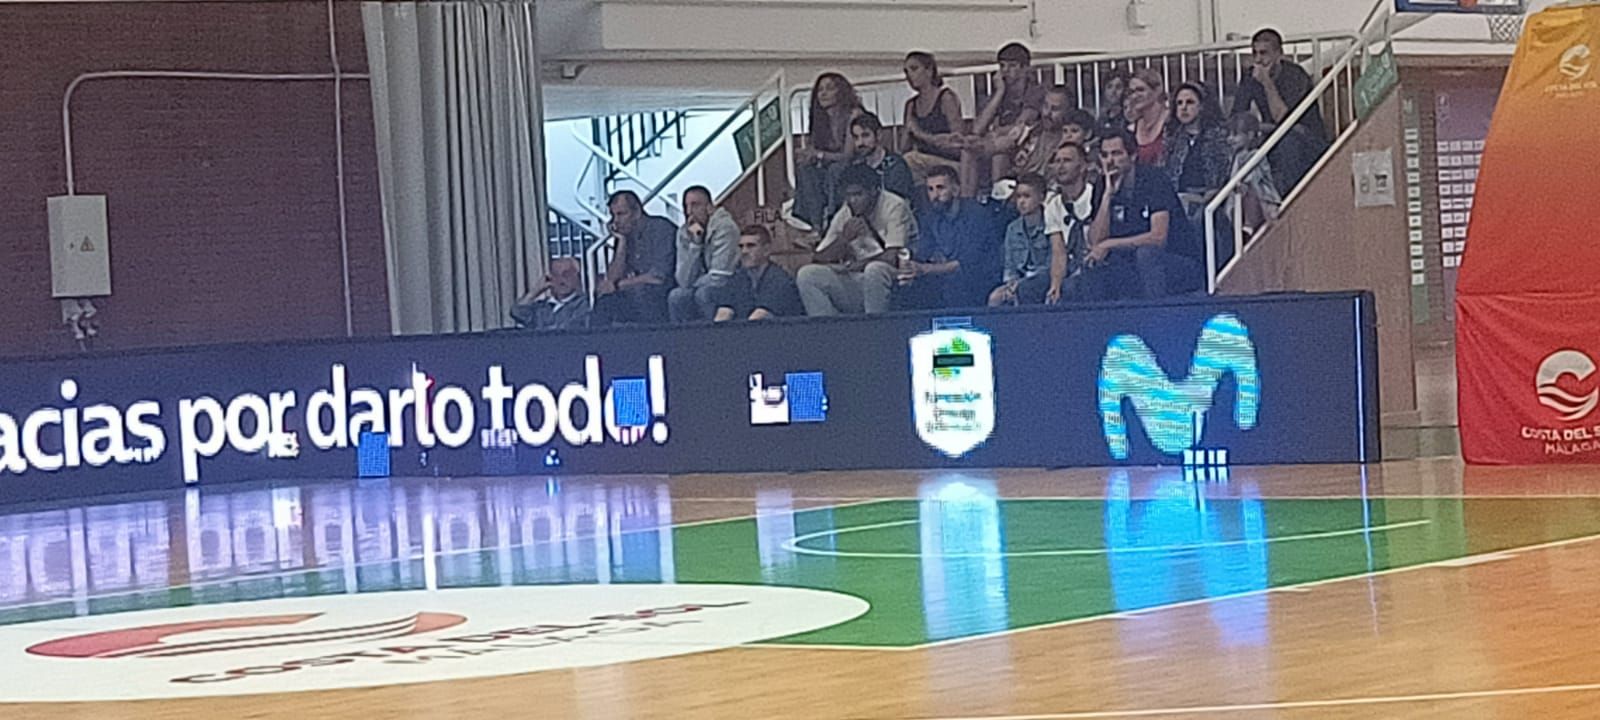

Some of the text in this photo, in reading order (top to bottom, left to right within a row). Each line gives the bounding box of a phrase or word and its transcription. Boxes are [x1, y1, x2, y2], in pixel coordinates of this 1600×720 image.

[753, 209, 783, 224] FILA
[178, 390, 298, 483] por
[1521, 426, 1562, 441] COSTA
[1563, 427, 1593, 440] DEL
[169, 645, 453, 683] COSTA
